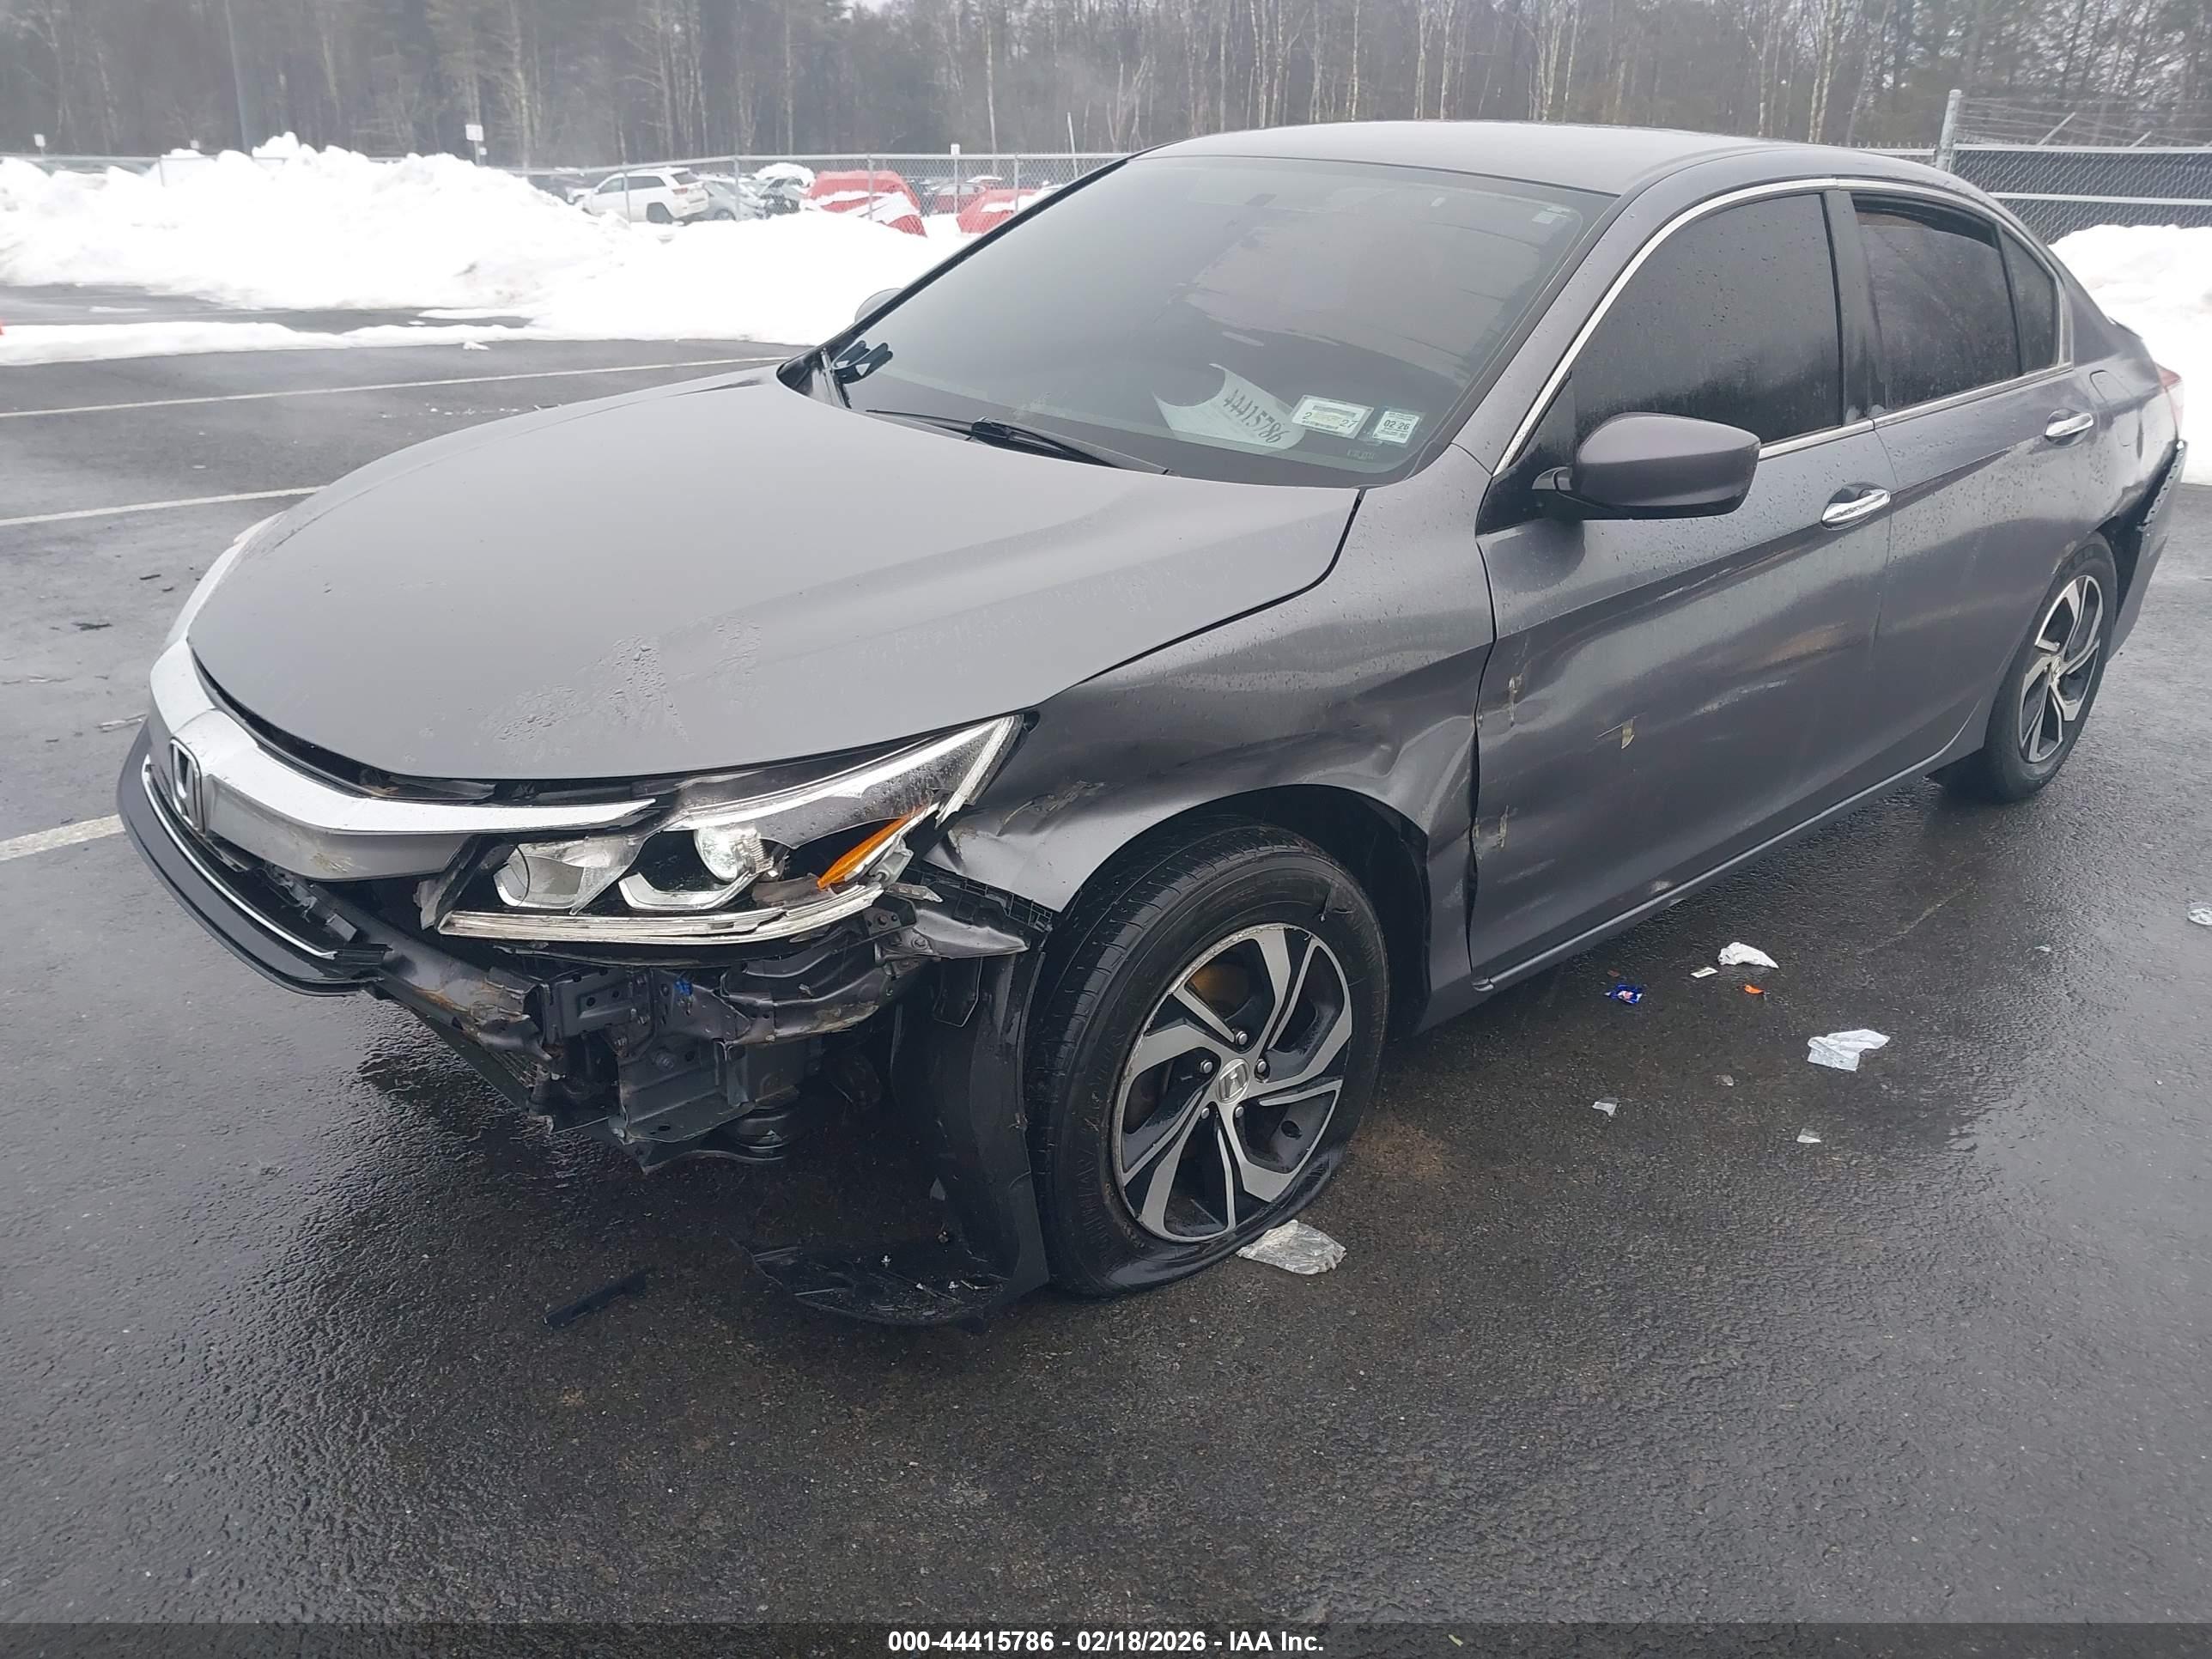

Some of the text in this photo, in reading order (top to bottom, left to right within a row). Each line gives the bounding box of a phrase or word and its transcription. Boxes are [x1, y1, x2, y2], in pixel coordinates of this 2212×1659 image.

[1223, 389, 1291, 443] 44415786
[1302, 411, 1313, 420] 2
[1340, 419, 1360, 428] 27
